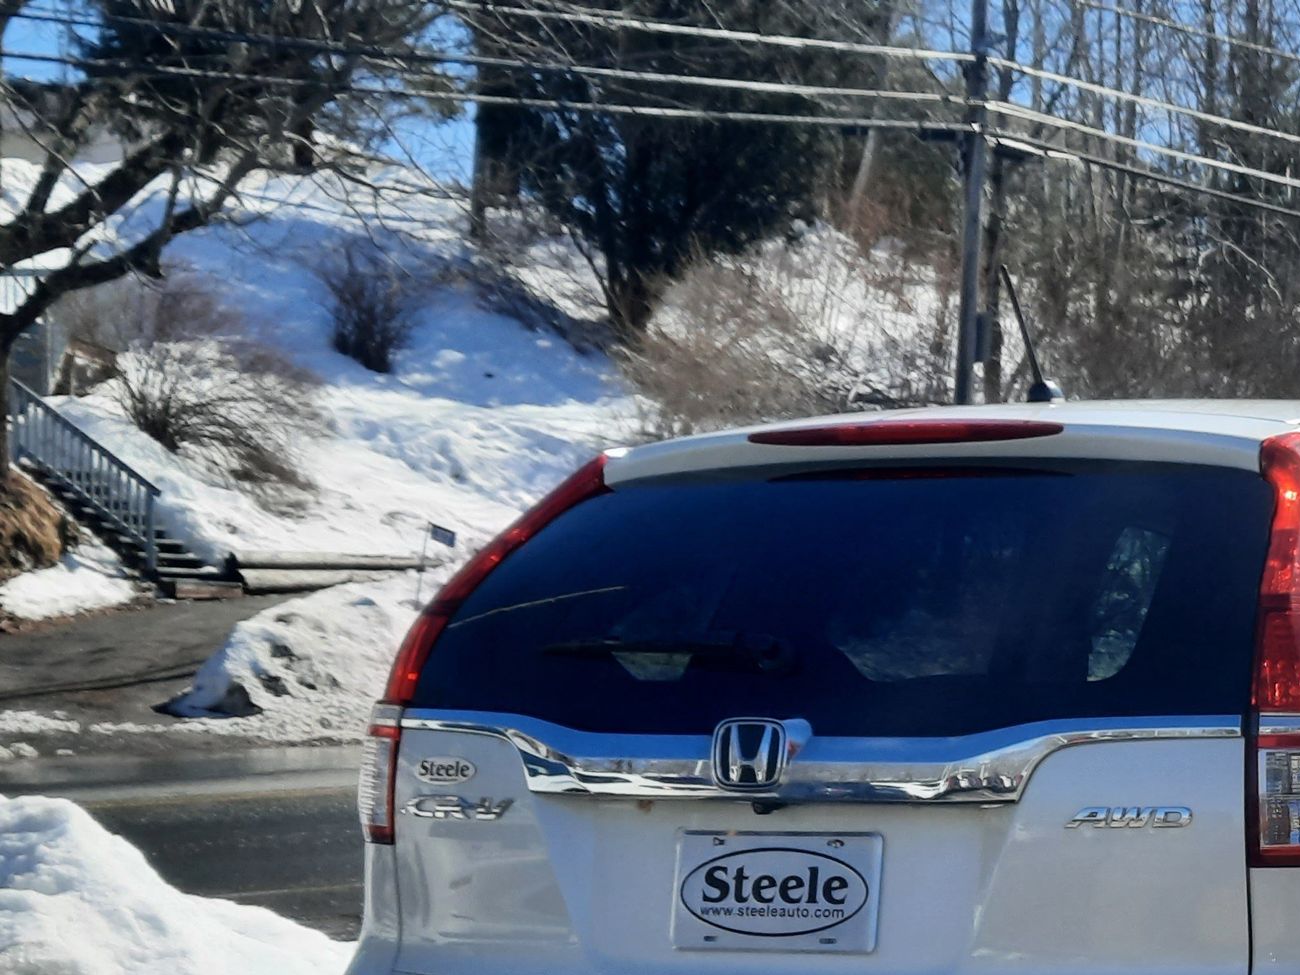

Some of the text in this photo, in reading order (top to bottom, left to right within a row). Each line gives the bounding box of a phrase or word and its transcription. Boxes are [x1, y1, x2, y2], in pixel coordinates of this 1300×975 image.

[420, 760, 470, 778] Steele
[1064, 806, 1193, 828] AWD
[702, 864, 849, 905] Steele
[700, 905, 845, 919] www.steeleauto.com
